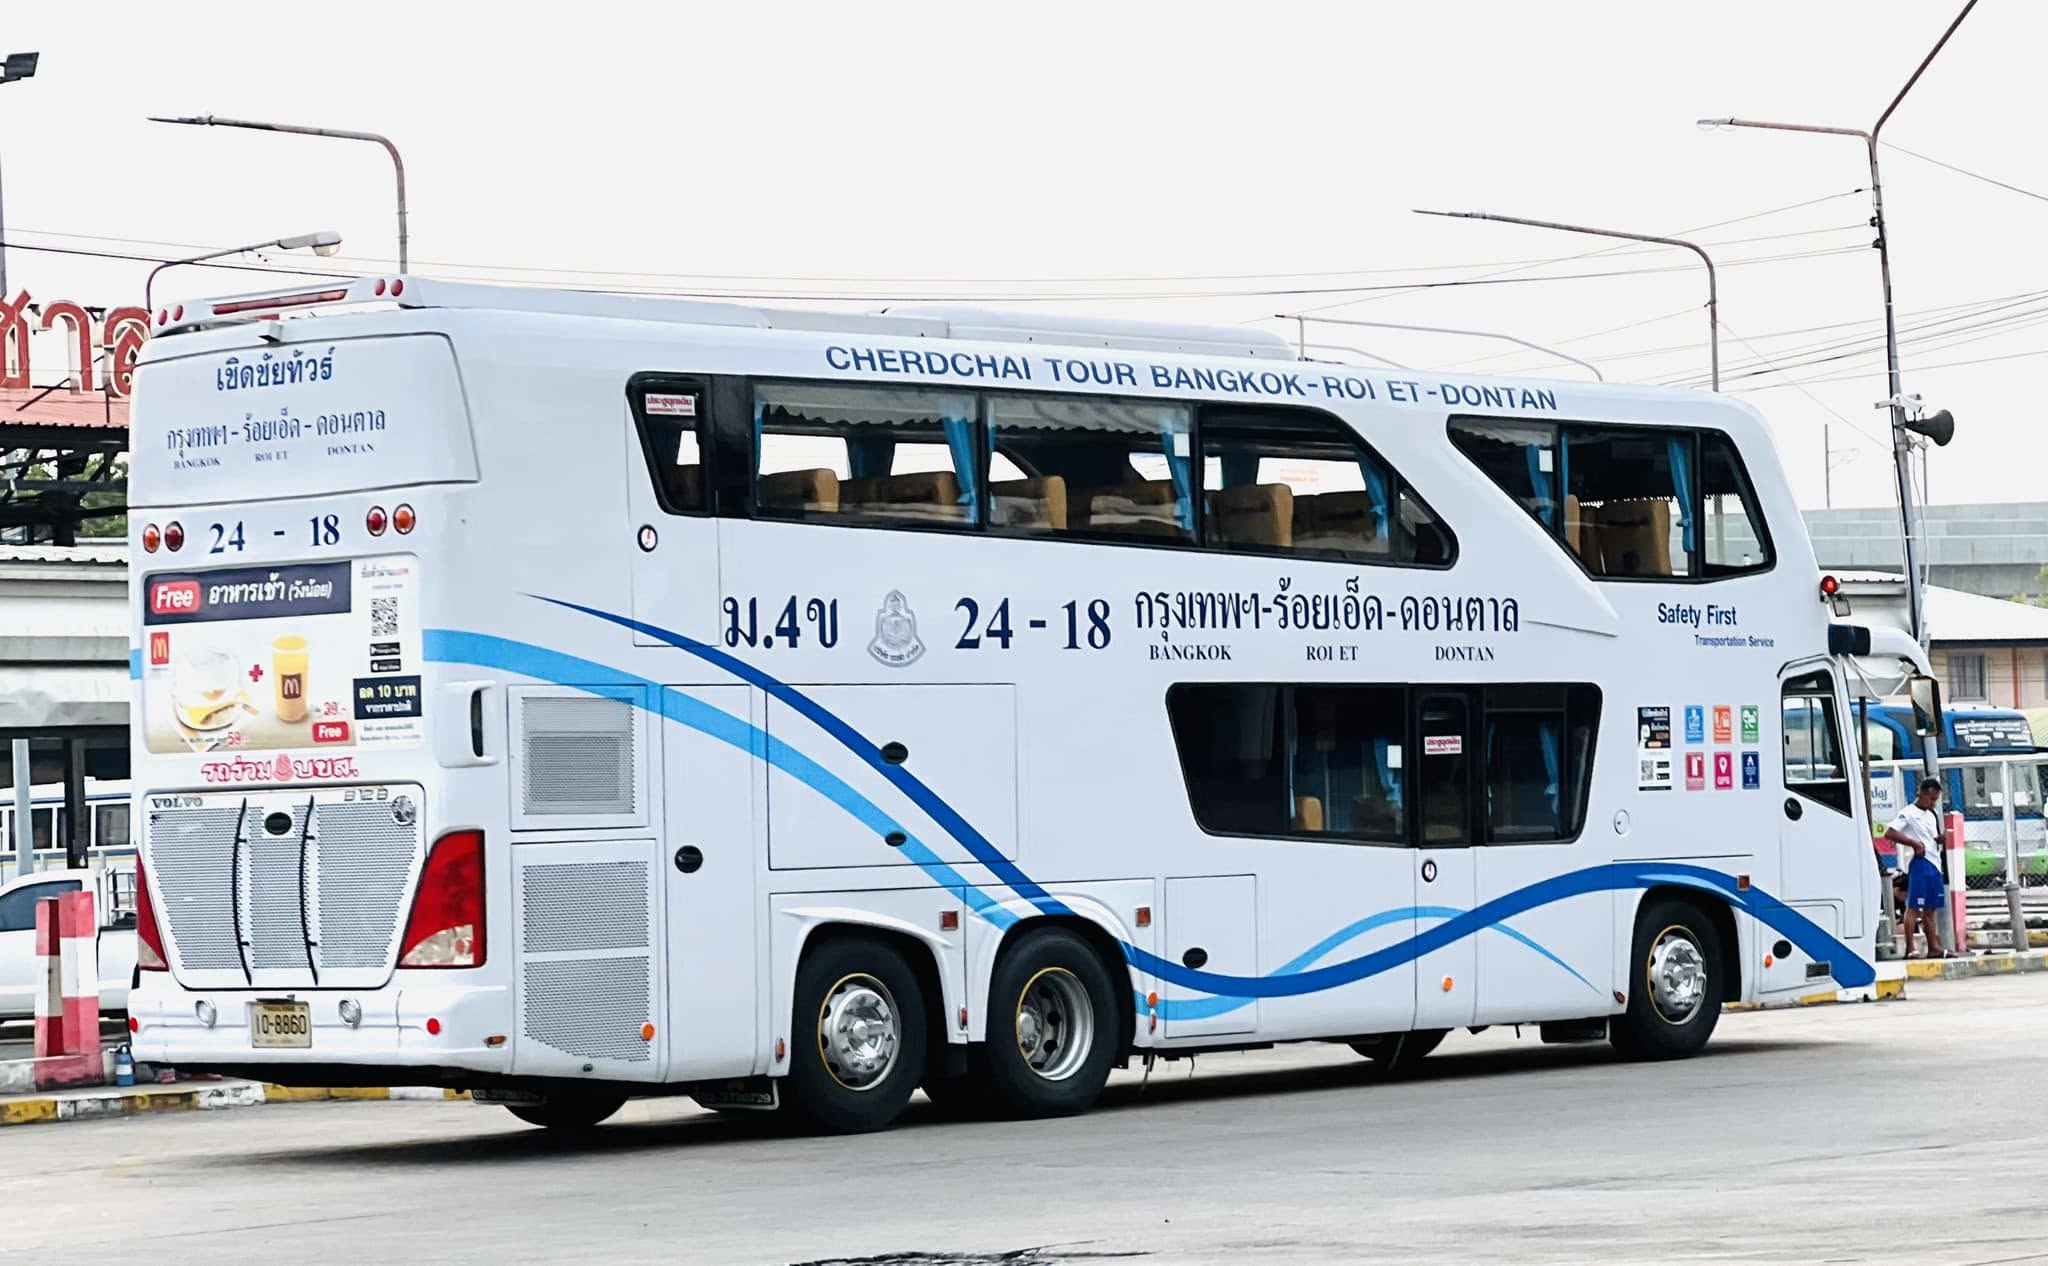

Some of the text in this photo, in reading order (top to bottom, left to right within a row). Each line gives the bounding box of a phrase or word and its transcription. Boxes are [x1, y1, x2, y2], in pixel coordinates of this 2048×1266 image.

[826, 346, 1032, 380] CHERDCHAI
[1044, 358, 1137, 386] TOUR
[316, 409, 386, 436] ดอนตาล
[174, 456, 221, 471] BANGKOK
[327, 443, 374, 456] DONTAN
[208, 521, 245, 554] 24
[308, 513, 341, 547] 18
[157, 585, 195, 610] Free
[208, 571, 285, 606] อาหารเช้า
[954, 597, 1014, 650] 24
[1061, 598, 1112, 650] 18
[1657, 602, 1738, 629] Safety First
[1149, 644, 1495, 662] BANGKOK ROI ET DONTAN
[1694, 634, 1775, 648] Transportation Service
[378, 684, 392, 698] 10
[318, 723, 343, 739] Free
[201, 755, 359, 783] รถร่วม บขส.
[152, 796, 203, 809] VOLVO
[255, 1013, 307, 1035] 10-8860
